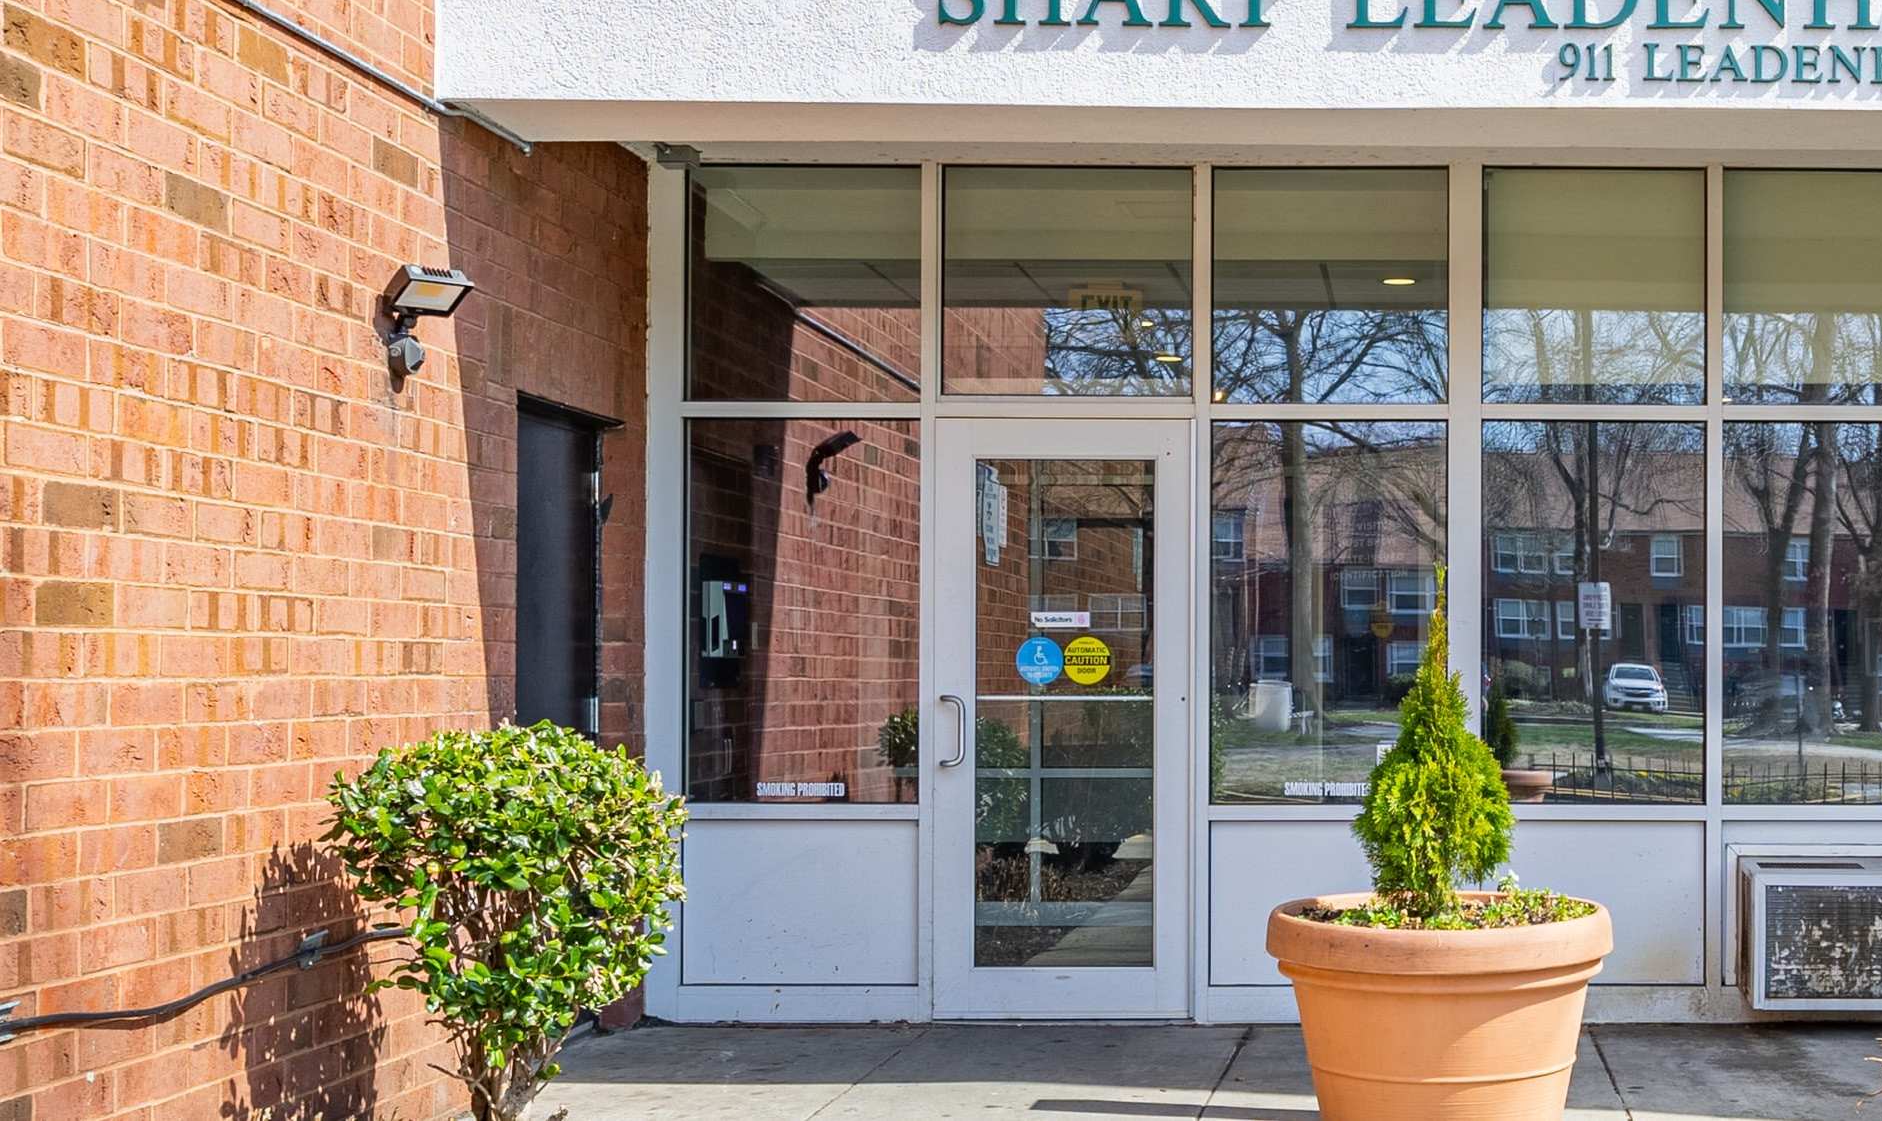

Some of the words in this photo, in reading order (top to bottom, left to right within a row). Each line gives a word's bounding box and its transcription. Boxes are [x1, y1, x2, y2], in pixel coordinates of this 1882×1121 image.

[1558, 43, 1615, 82] 911
[1067, 646, 1106, 654] AUTOMATIC
[1065, 656, 1107, 665] CAUTION
[756, 782, 796, 797] SMOKING
[797, 782, 845, 797] PROHIBITED
[1284, 782, 1323, 796] SMOKING
[1324, 782, 1371, 796] PROHIBITE
